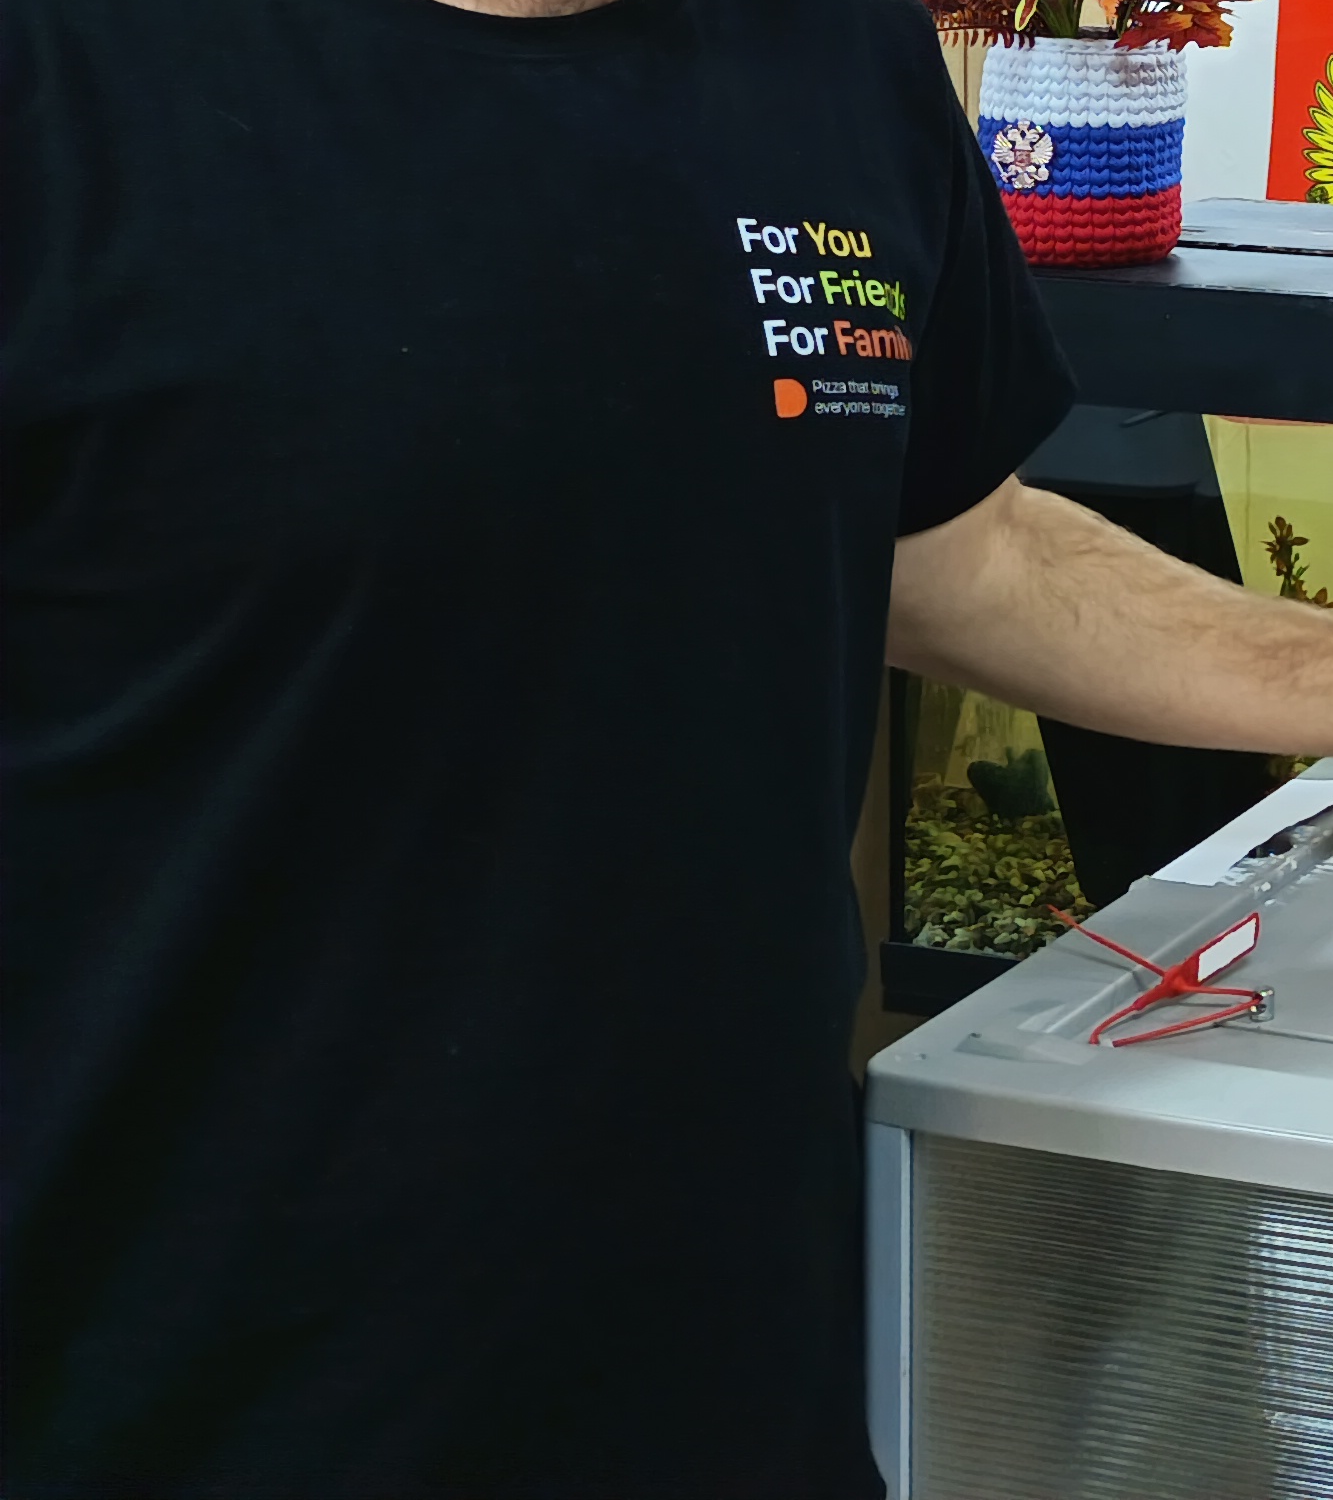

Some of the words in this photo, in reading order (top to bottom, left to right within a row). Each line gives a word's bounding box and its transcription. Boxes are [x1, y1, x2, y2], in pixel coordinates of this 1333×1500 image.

[736, 217, 799, 255] For
[802, 220, 873, 259] You
[750, 268, 815, 304] For
[762, 319, 829, 357] For
[811, 378, 847, 394] Pizza
[848, 378, 870, 394] that
[814, 401, 871, 417] everyone
